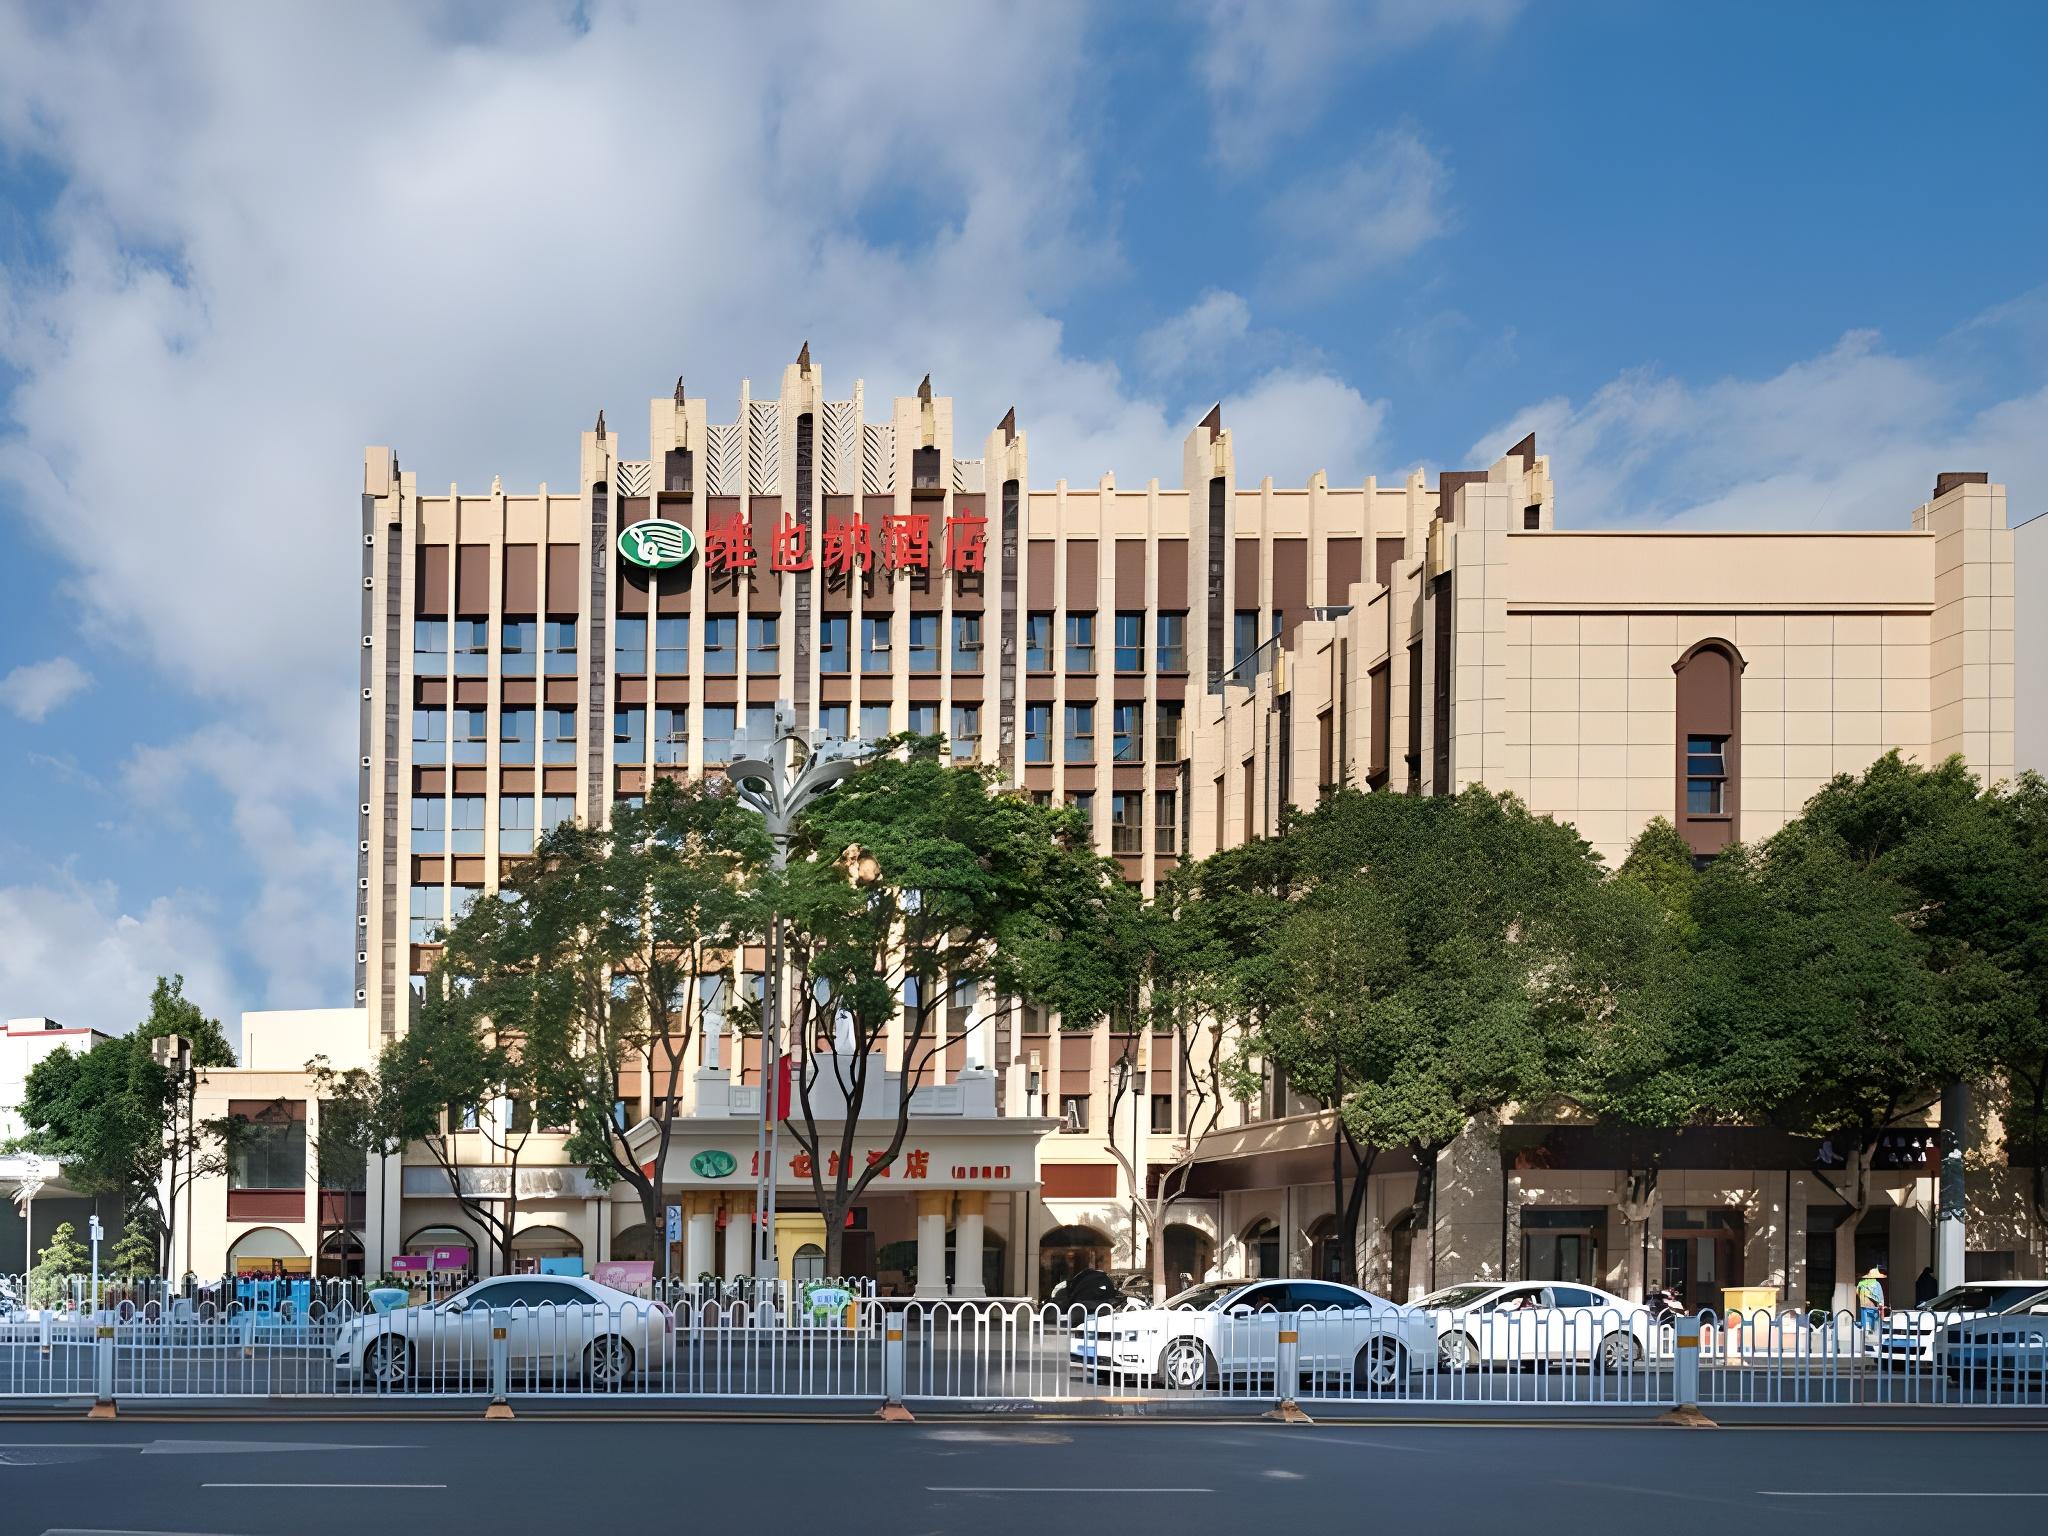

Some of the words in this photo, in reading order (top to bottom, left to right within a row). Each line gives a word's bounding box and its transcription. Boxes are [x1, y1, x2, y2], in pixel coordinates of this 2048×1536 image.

[704, 506, 989, 573] 维也纳酒店
